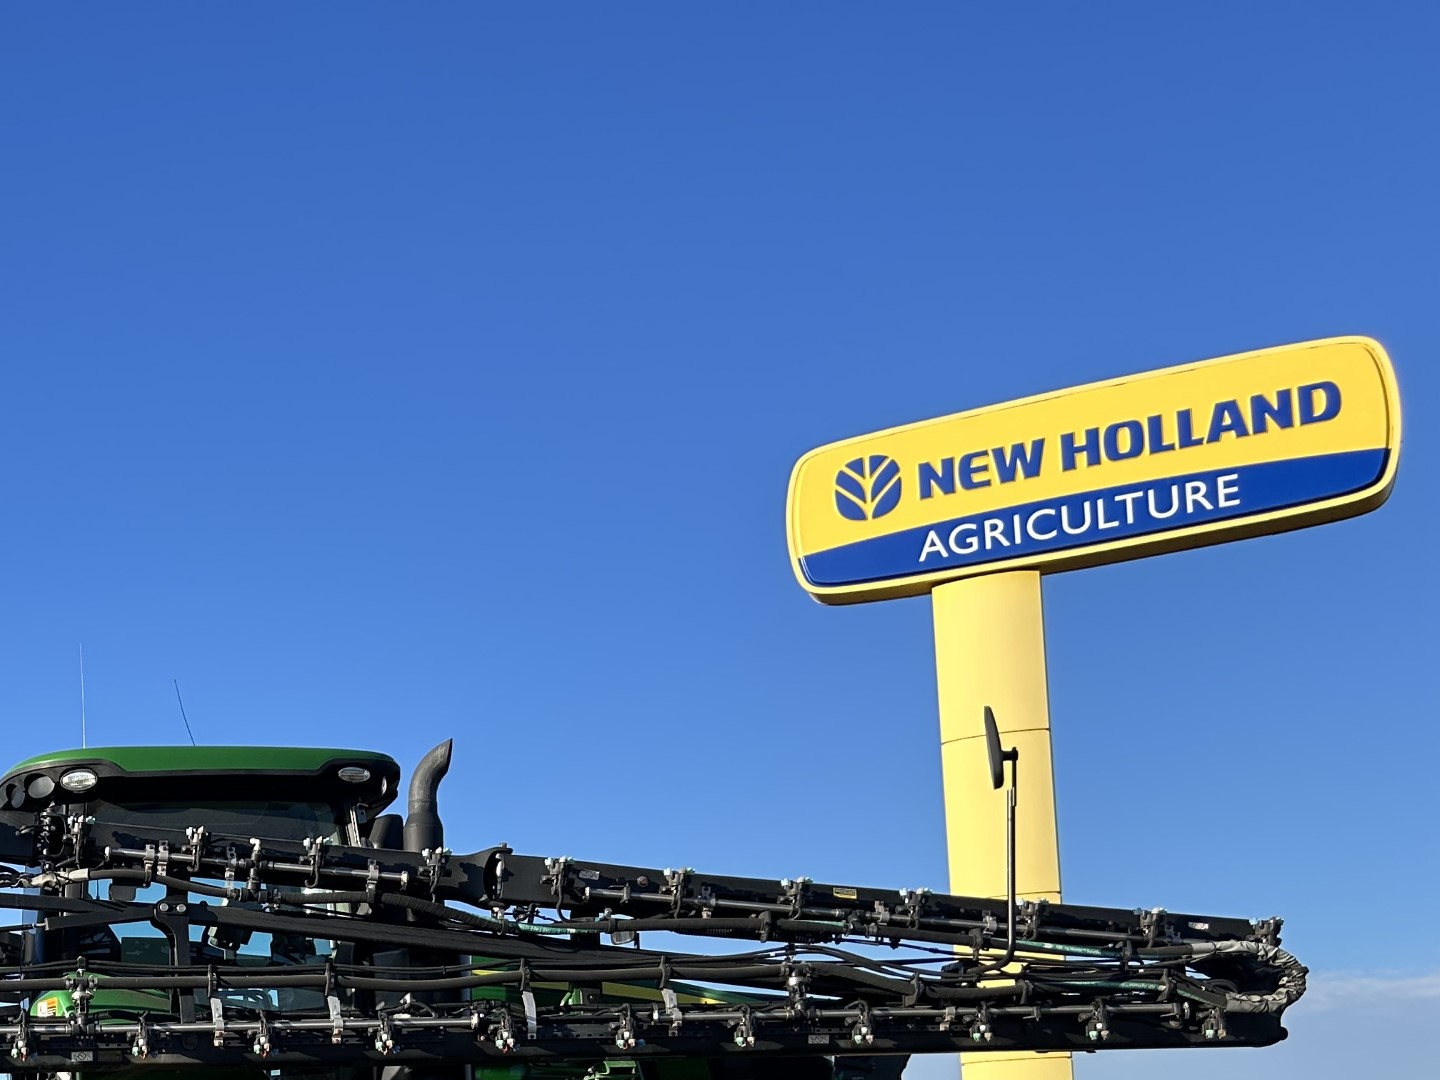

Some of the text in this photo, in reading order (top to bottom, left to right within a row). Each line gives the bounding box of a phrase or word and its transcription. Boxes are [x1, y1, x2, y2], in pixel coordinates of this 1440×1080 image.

[918, 380, 1343, 501] NEW HOLLAND
[918, 472, 1241, 563] AGRICULTURE
